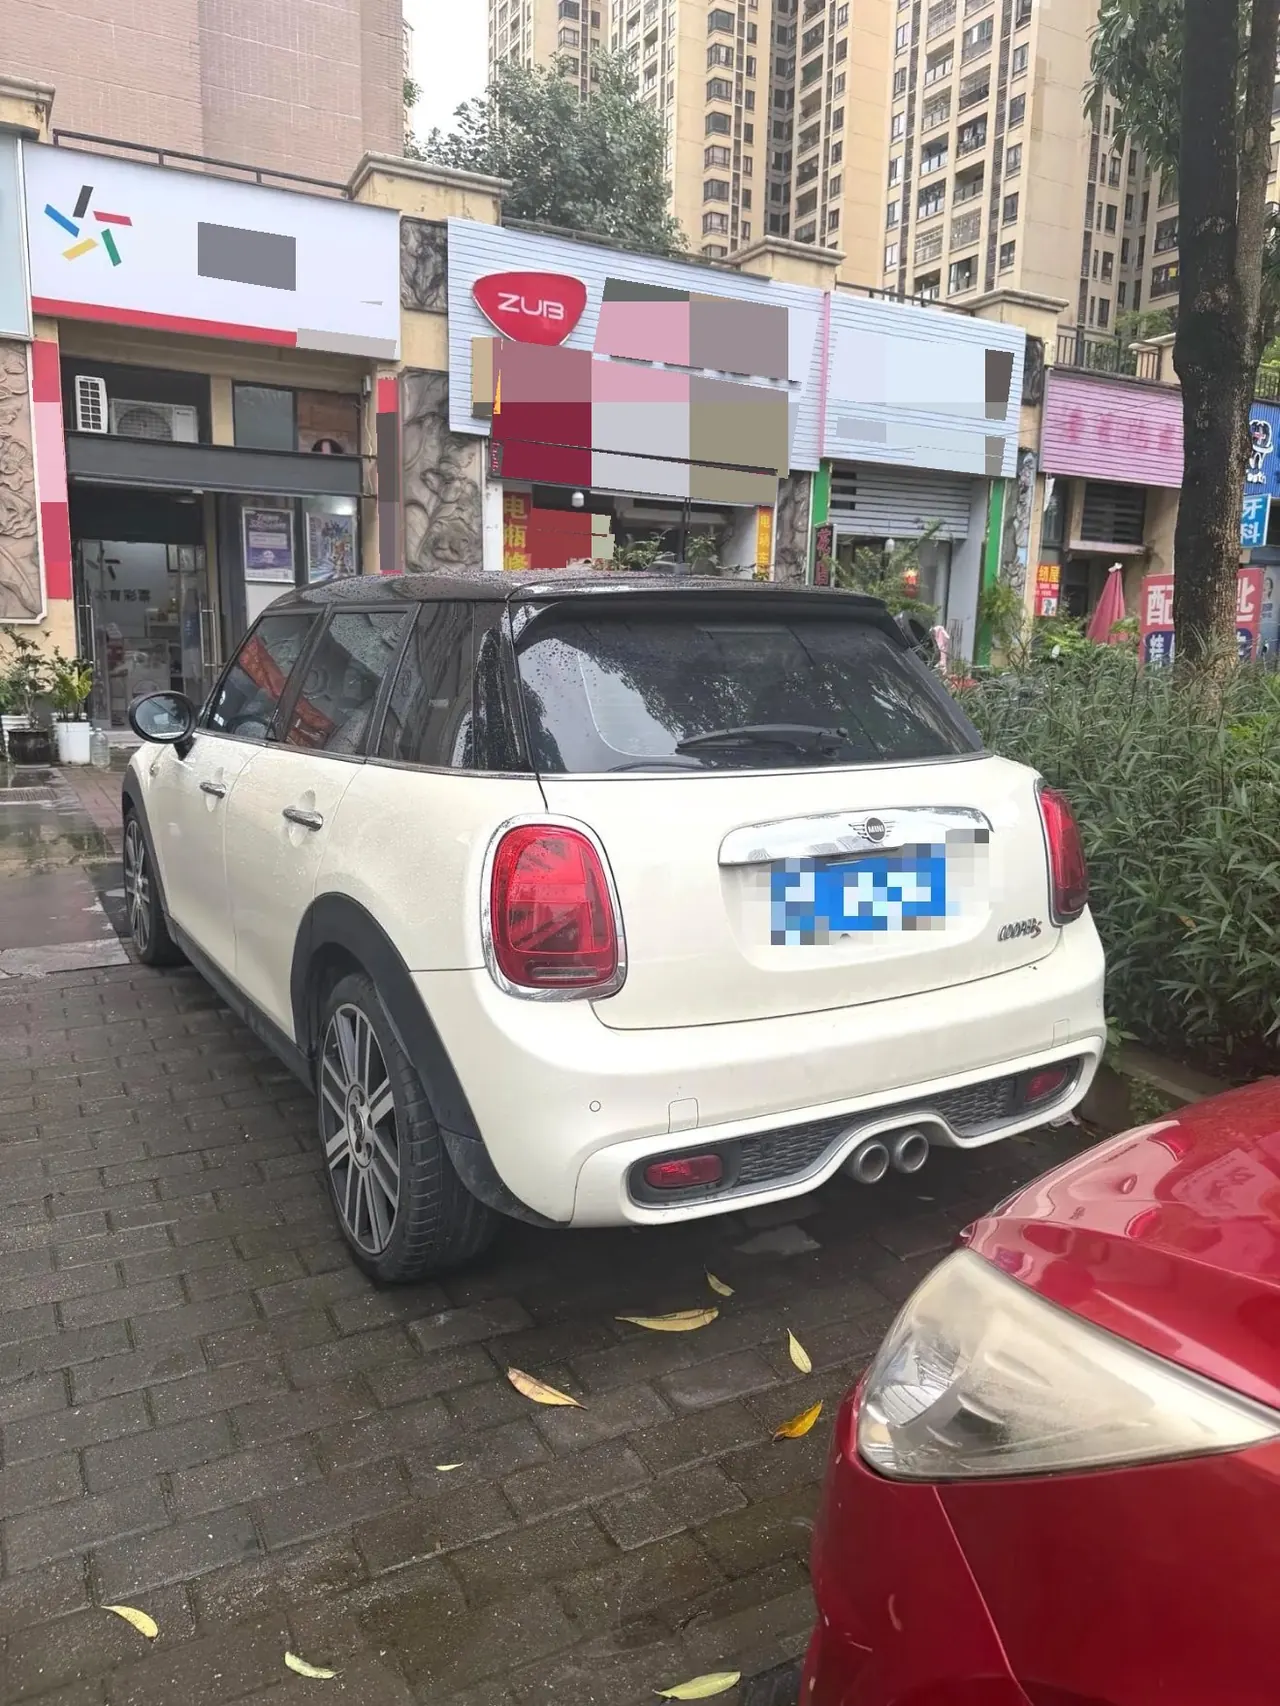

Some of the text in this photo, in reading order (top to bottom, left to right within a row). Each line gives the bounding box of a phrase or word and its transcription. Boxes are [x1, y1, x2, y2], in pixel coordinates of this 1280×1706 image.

[497, 291, 565, 320] ZUB
[1242, 498, 1263, 543] 牙科
[868, 824, 884, 833] MINI
